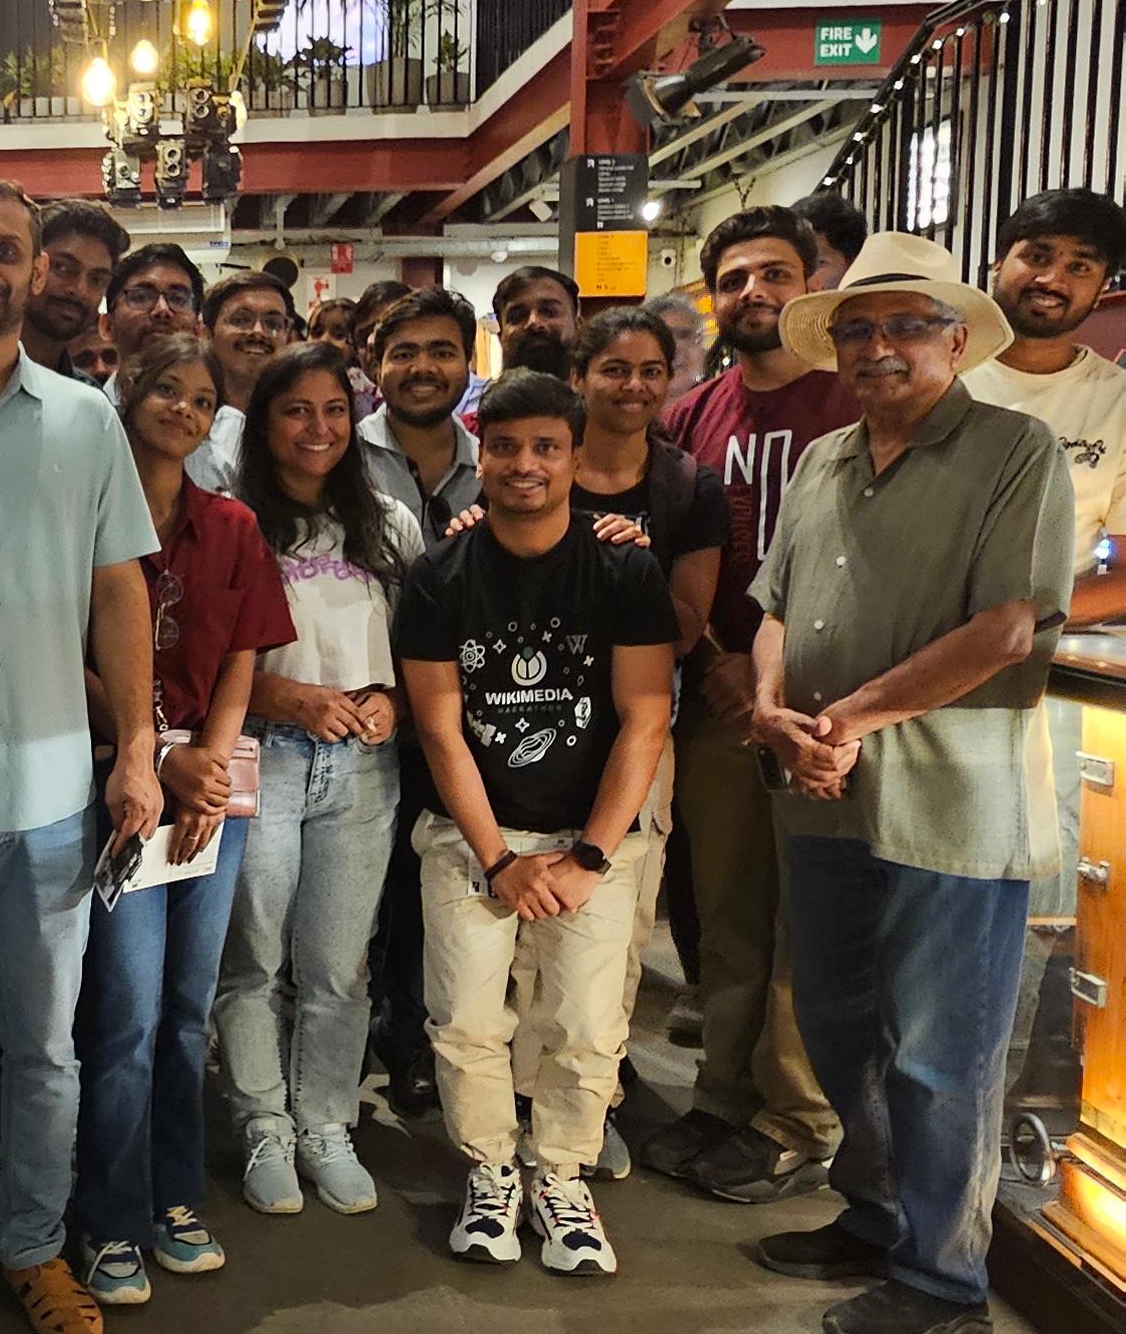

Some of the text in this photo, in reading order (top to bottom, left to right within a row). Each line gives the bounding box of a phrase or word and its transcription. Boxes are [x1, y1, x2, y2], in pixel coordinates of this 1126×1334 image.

[820, 26, 853, 41] FIRE
[820, 43, 853, 58] EXIT
[485, 687, 574, 706] WIKIMEDIA
